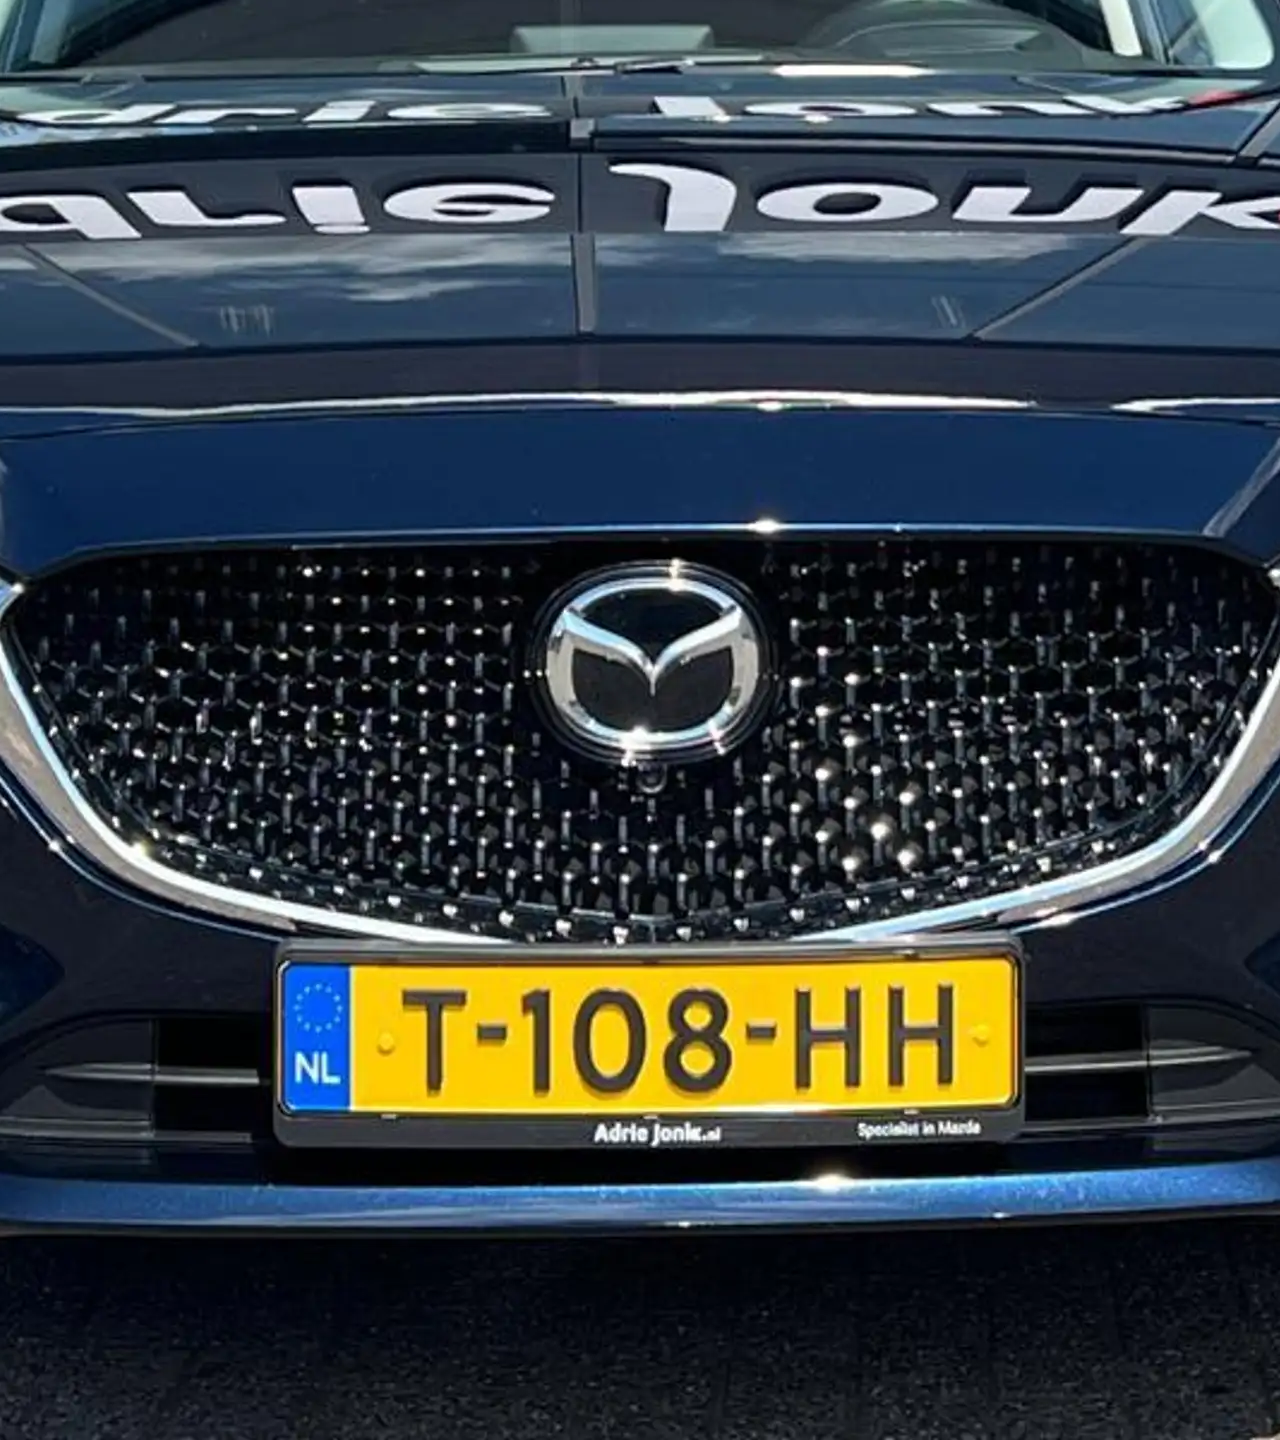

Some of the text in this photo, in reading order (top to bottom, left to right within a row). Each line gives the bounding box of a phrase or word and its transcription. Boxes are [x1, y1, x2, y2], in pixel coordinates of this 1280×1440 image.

[402, 984, 954, 1096] T-108-HH
[294, 1051, 342, 1084] NL
[594, 1121, 649, 1143] Adrie
[922, 1121, 936, 1135] in
